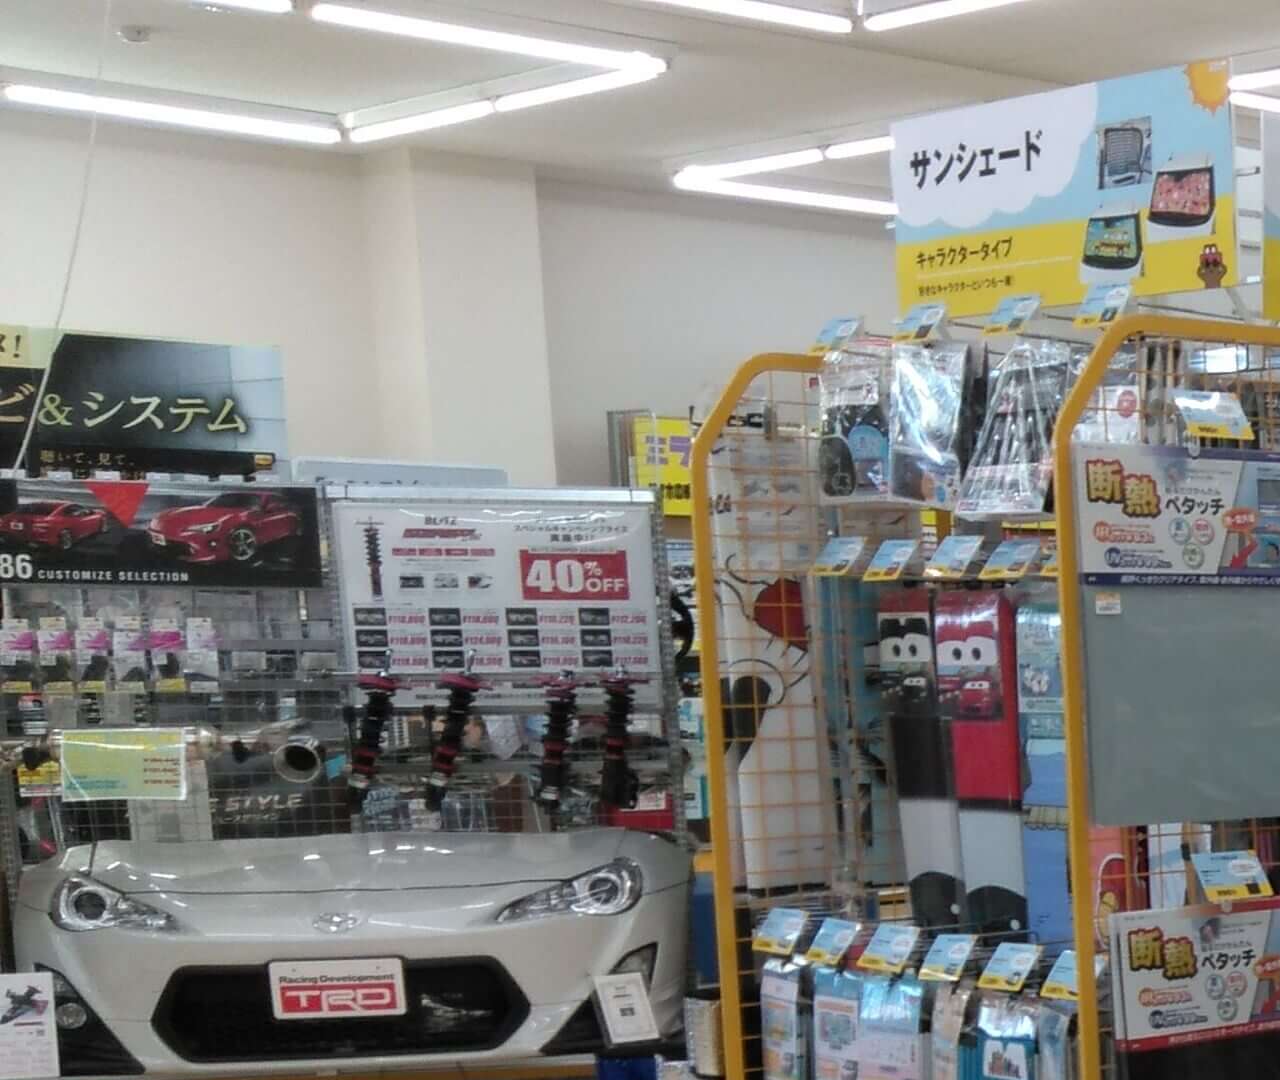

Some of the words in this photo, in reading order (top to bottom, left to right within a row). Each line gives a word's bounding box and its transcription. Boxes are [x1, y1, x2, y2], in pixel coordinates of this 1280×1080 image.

[910, 130, 1042, 190] サンシェード
[916, 236, 1013, 269] キャラクタータイプ
[1087, 459, 1161, 518] 断熱
[1165, 498, 1225, 516] ペタッチ
[38, 570, 113, 583] CUSTOMIZE
[118, 571, 189, 583] SELECTION
[585, 579, 625, 593] OFF
[1202, 949, 1257, 971] ペタッチ
[279, 975, 315, 986] Racing
[318, 973, 395, 985] Development
[283, 988, 394, 1012] TRD
